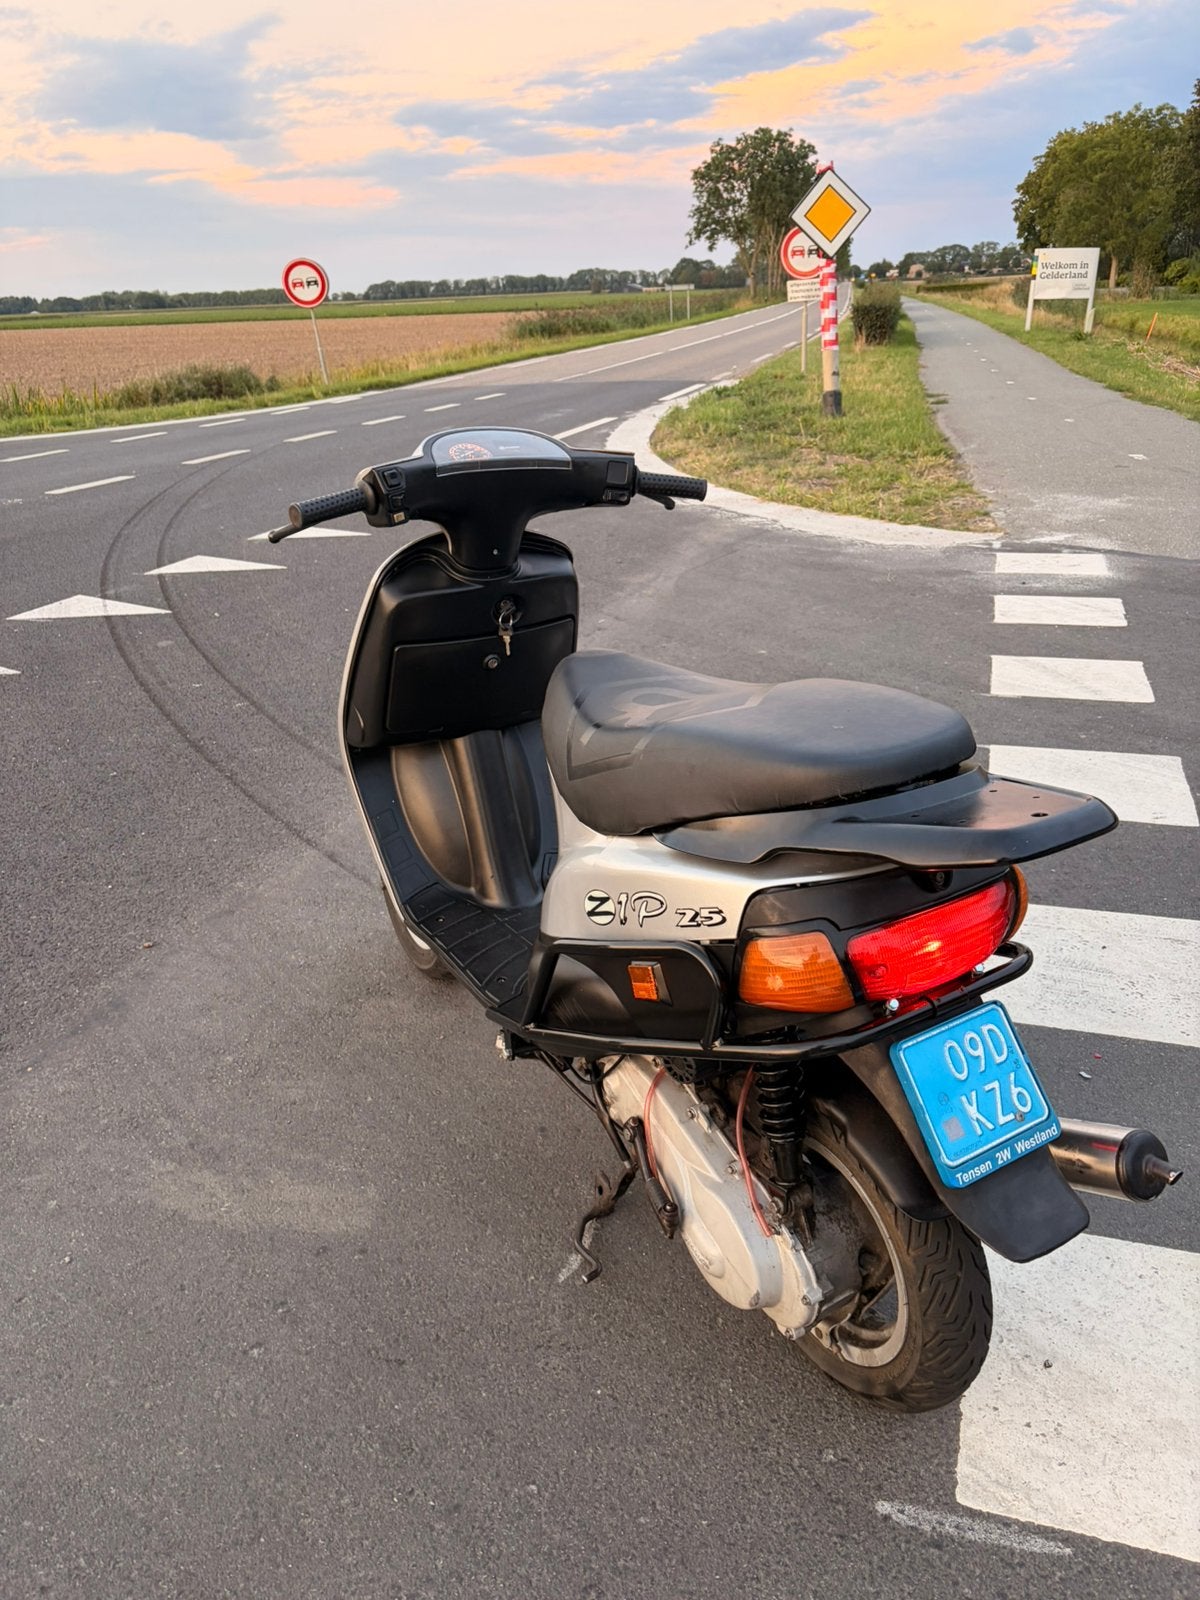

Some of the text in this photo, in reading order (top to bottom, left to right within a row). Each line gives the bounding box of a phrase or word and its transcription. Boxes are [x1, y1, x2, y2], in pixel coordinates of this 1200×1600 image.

[1040, 270, 1088, 279] Gelderland
[1041, 260, 1089, 270] Welkom in
[675, 907, 727, 928] 25
[943, 1023, 1008, 1081] 09D
[960, 1071, 1032, 1136] KZ6
[955, 1159, 993, 1186] Tensen
[995, 1148, 1012, 1166] 2W
[1014, 1123, 1059, 1155] Westland
